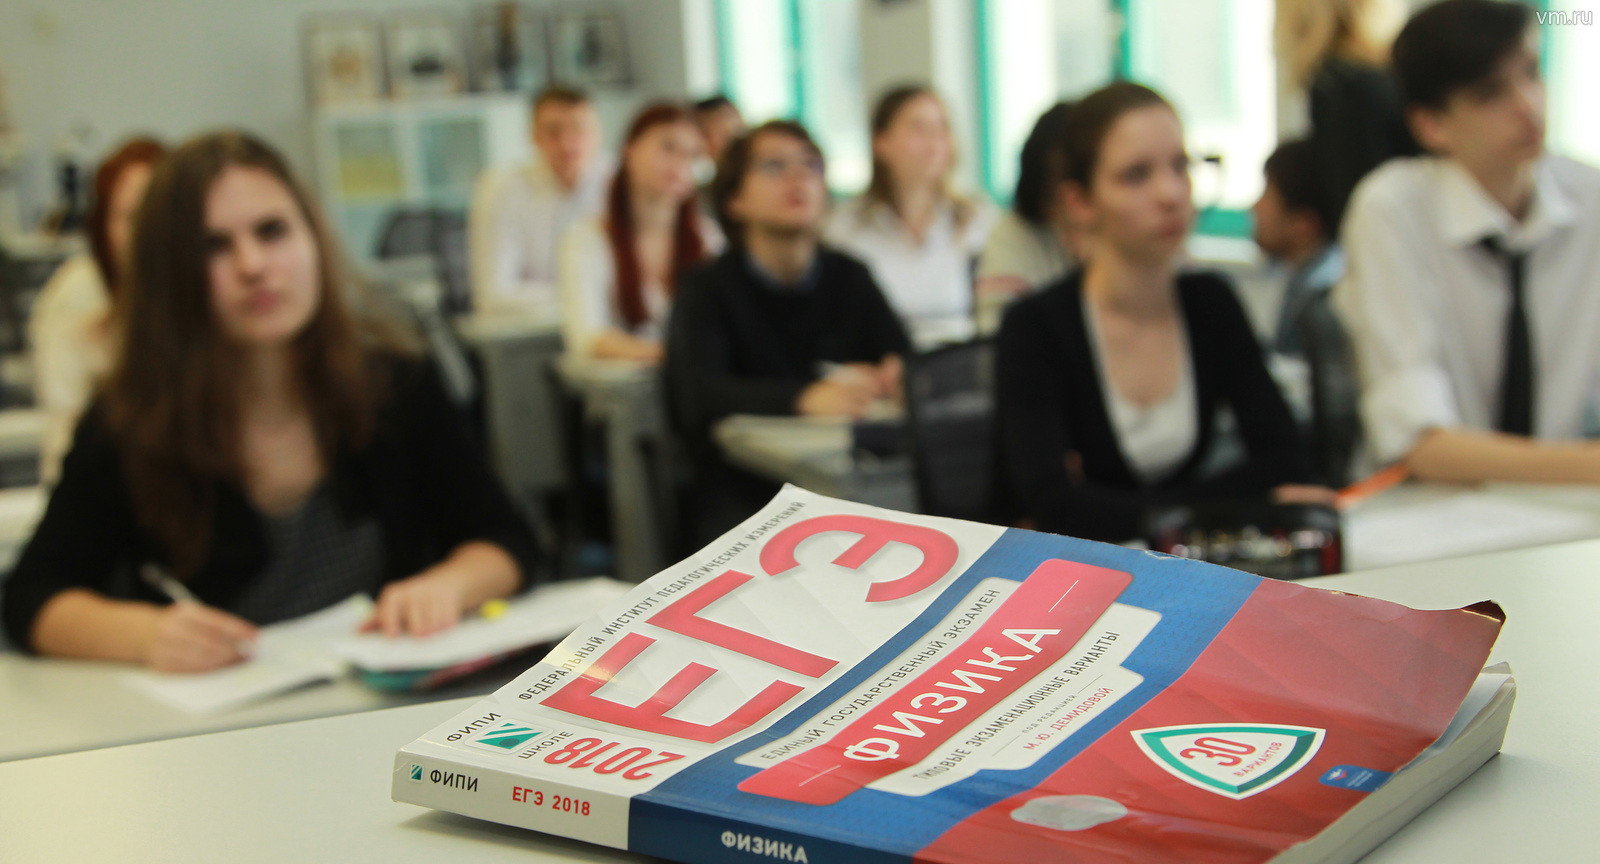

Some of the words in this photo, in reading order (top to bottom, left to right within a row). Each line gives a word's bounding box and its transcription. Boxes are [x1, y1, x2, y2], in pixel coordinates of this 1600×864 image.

[518, 636, 606, 700] ФЕДЕРАЛЬНЫЙ
[601, 597, 659, 635] ИНСТИТУТ
[656, 541, 750, 598] ПЕДАГОГИЧЕСКИХ
[745, 501, 807, 541] ИЗМЕРЕНИЙ
[539, 513, 960, 744] ЕГЭ
[761, 728, 826, 760] ЕДИНЫЙ
[822, 640, 948, 727] ГОСУДАРСТВЕННЫЙ
[943, 589, 1000, 640] ЭКЗАМЕН
[843, 627, 1062, 762] ФИЗИКА
[446, 712, 502, 743] ФИПИ
[912, 748, 972, 780] ТИПОВЫЕ
[965, 676, 1071, 748] ЭКЗАМЕНАЦИОННЫЕ
[1064, 631, 1121, 676] ВАРИАНТЫ
[1050, 687, 1115, 732] ДЕМИДОВОЙ
[518, 731, 575, 760] ШКОЛЕ
[543, 737, 687, 781] 2018
[1179, 736, 1257, 767] 30
[430, 768, 479, 793] ФИПИ
[512, 786, 544, 806] ЕГЭ
[552, 795, 591, 816] 2018
[720, 830, 808, 864] ФИЗИКА
